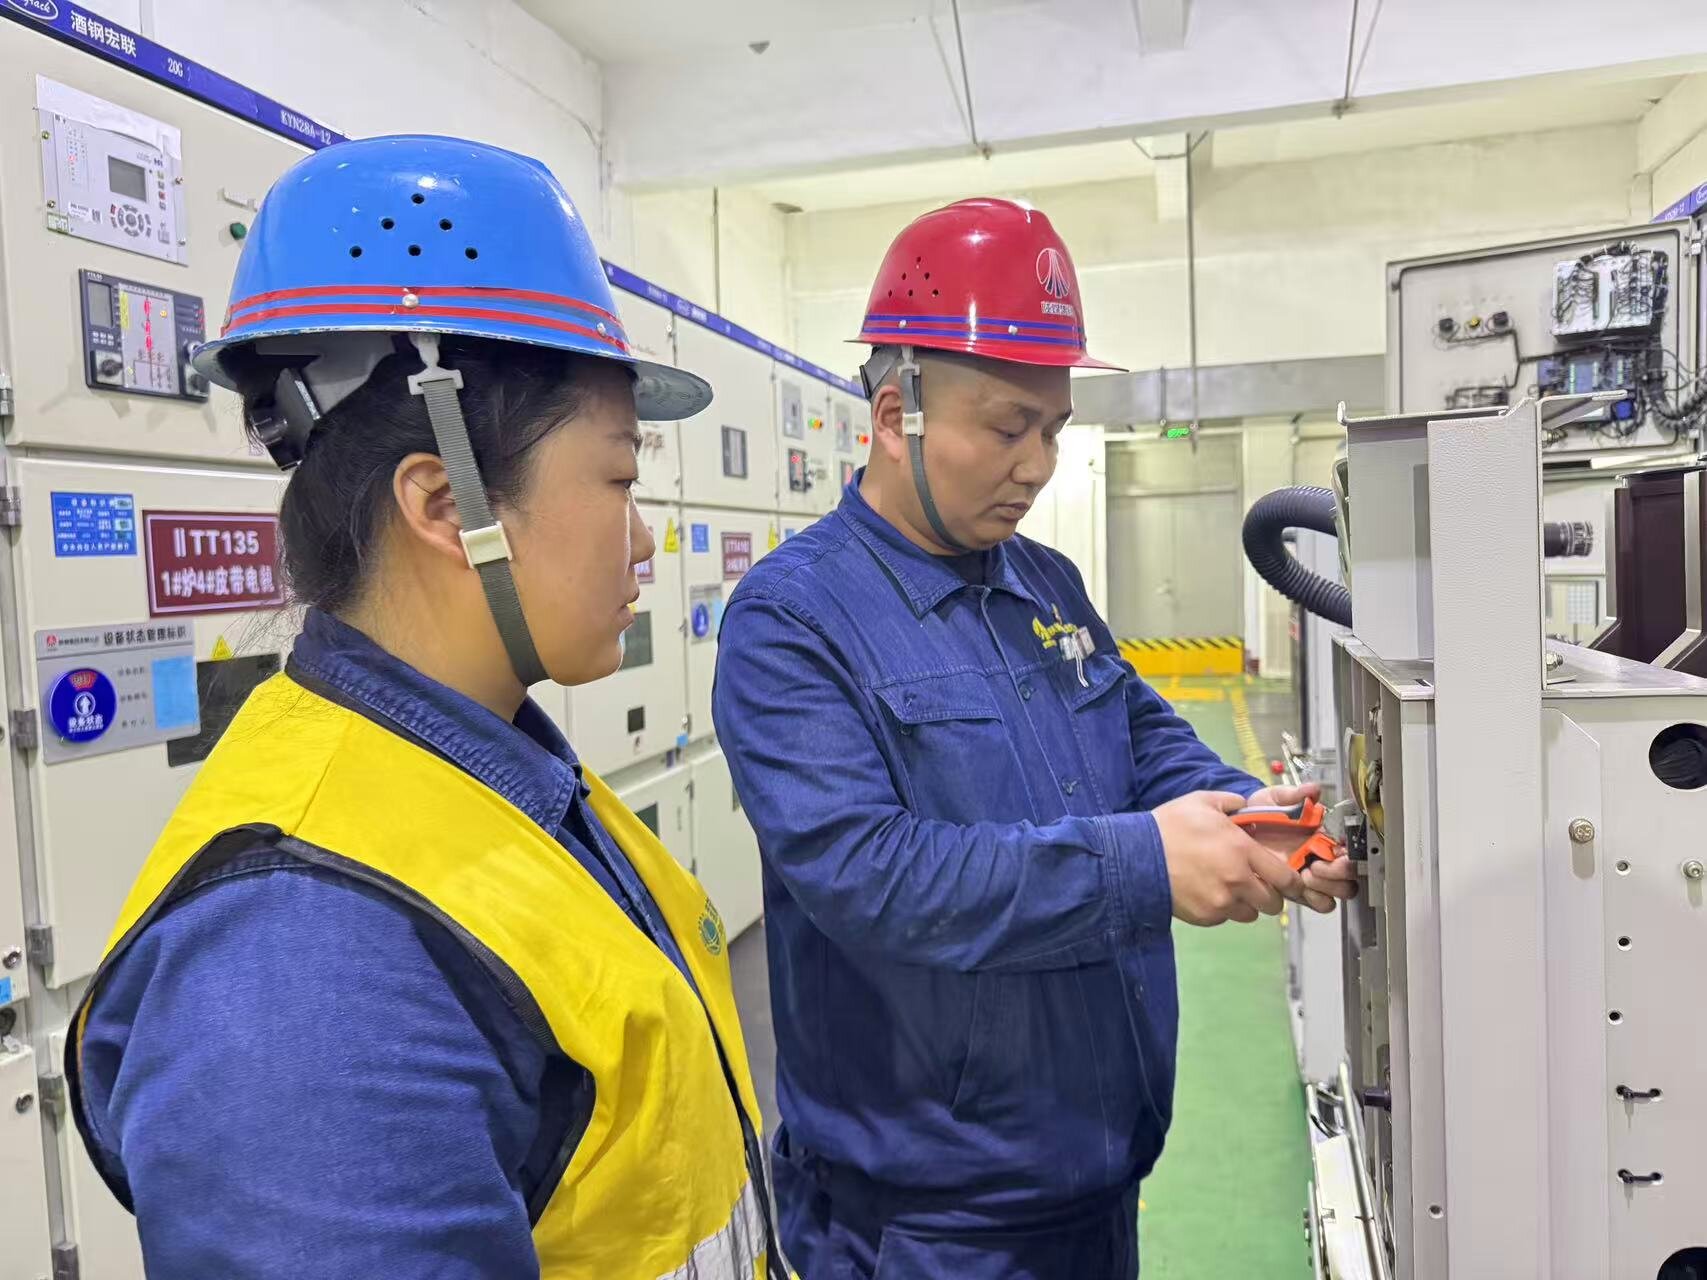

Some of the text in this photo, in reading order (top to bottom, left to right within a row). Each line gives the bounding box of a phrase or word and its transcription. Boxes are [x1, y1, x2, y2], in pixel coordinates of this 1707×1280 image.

[70, 10, 137, 58] 酒钢宏联
[167, 57, 184, 78] 20G
[280, 110, 332, 146] KYN28A-12
